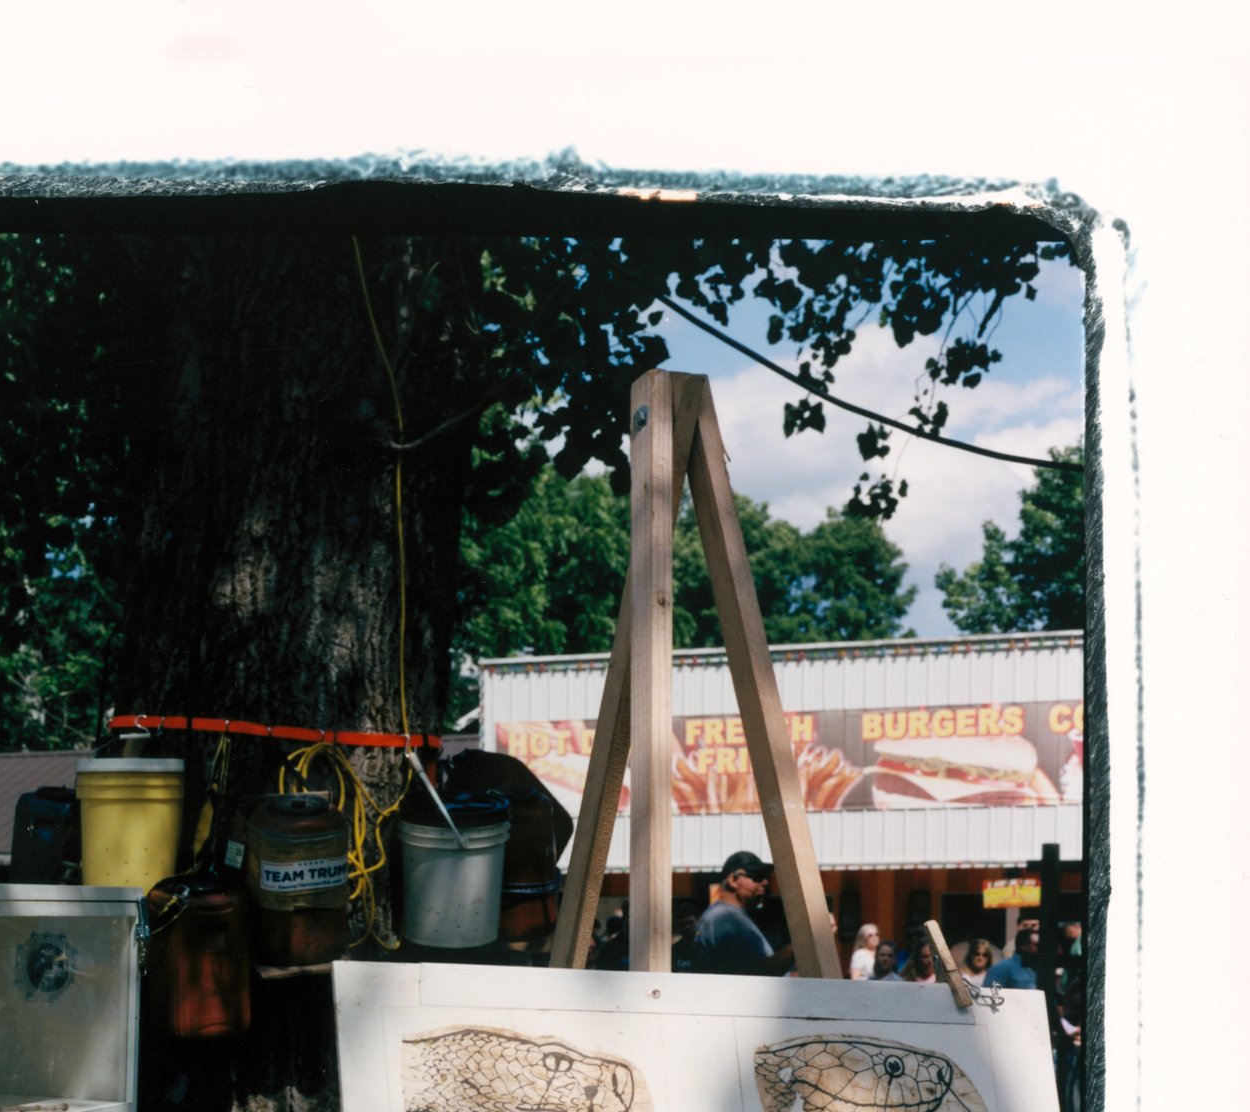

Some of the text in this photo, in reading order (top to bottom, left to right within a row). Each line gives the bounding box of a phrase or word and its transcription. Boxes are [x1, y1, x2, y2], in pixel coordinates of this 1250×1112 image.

[685, 714, 813, 746] FREH
[862, 706, 1025, 740] BURGERS
[509, 730, 571, 757] HOT
[697, 747, 749, 775] FRI
[264, 869, 304, 882] TEAM
